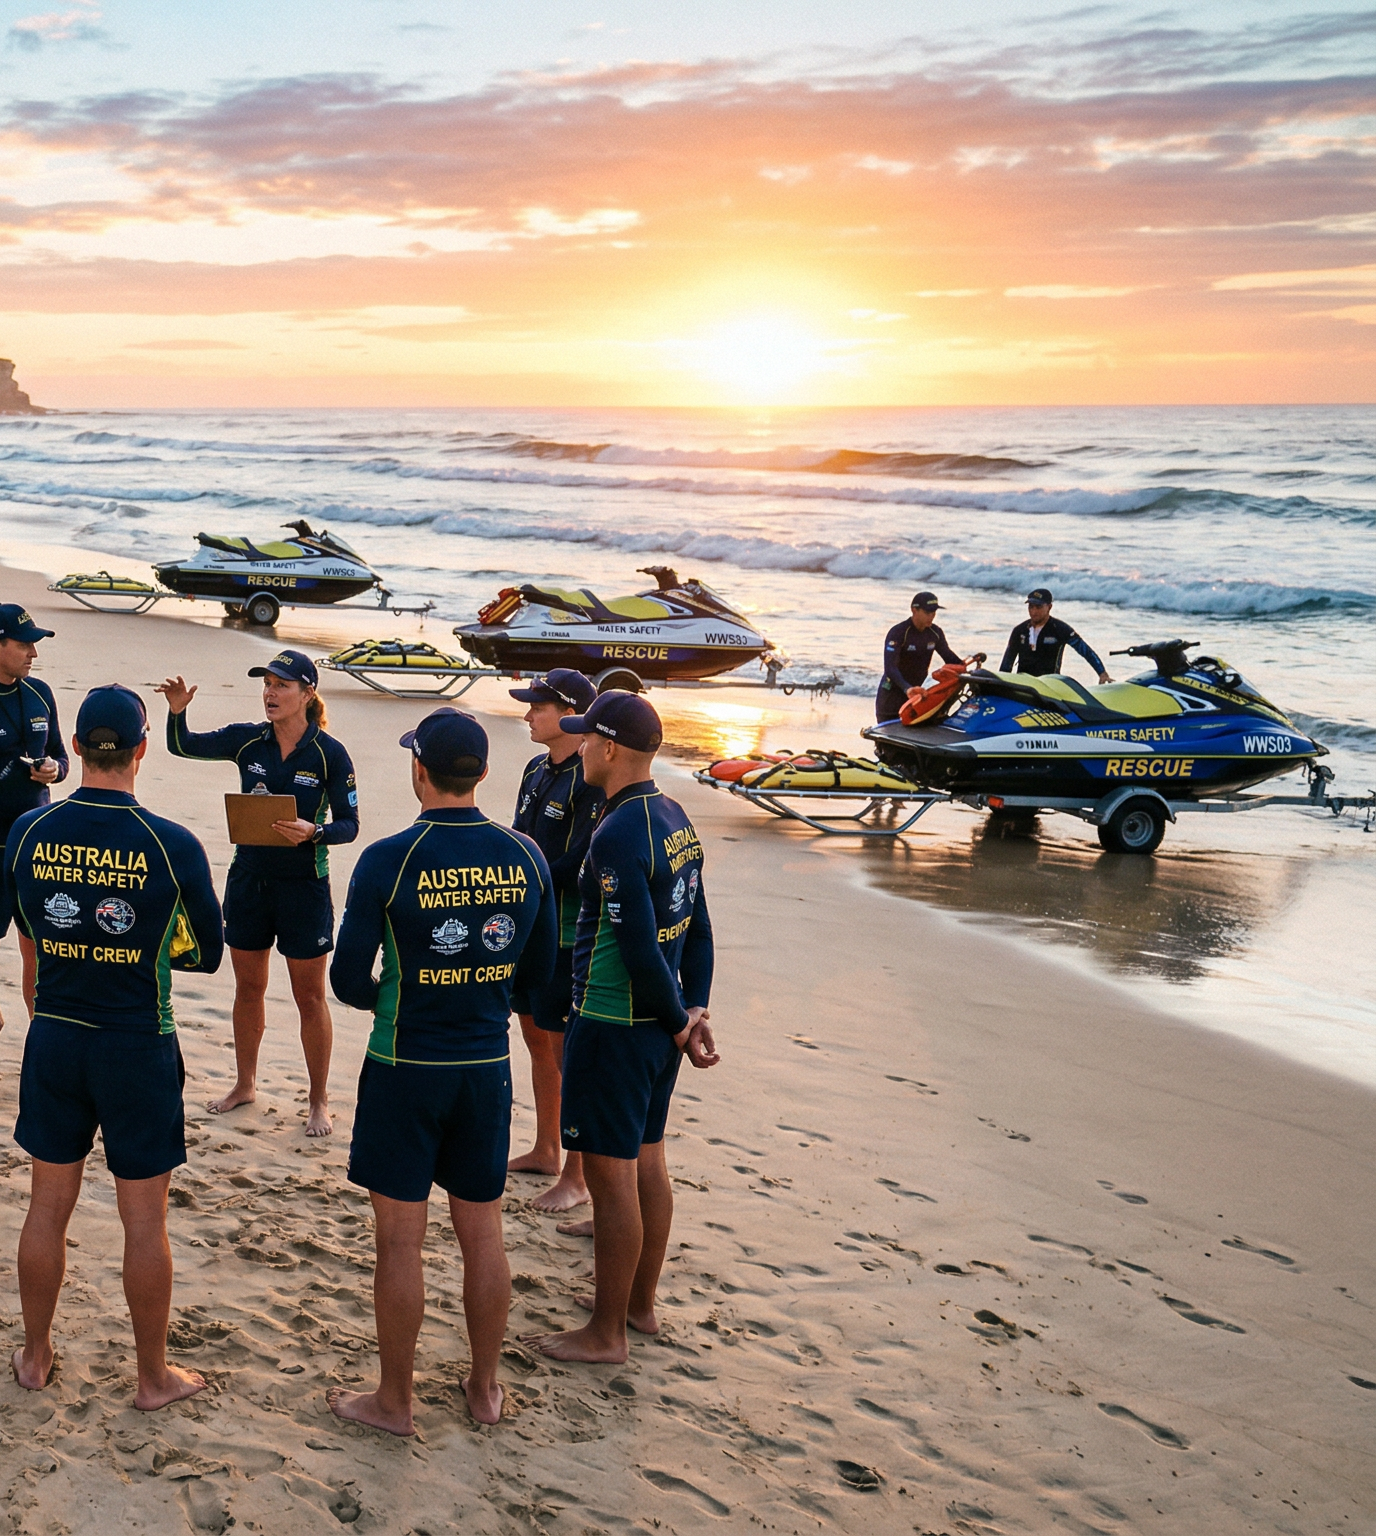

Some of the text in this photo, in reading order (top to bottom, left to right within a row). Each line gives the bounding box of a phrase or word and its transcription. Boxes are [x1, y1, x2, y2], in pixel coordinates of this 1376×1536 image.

[602, 645, 669, 660] RESCUE
[1129, 727, 1176, 742] SAFETY
[1242, 735, 1292, 753] WWS03
[1104, 759, 1195, 778] RESCUE
[32, 842, 149, 872] AUSTRALIA
[32, 864, 148, 890] WATER SAFETY
[417, 865, 528, 890] AUSTRALIA
[418, 887, 527, 909] WATER SAFETY
[42, 938, 142, 963] EVENT CREW
[419, 963, 516, 985] EVENT CREW
